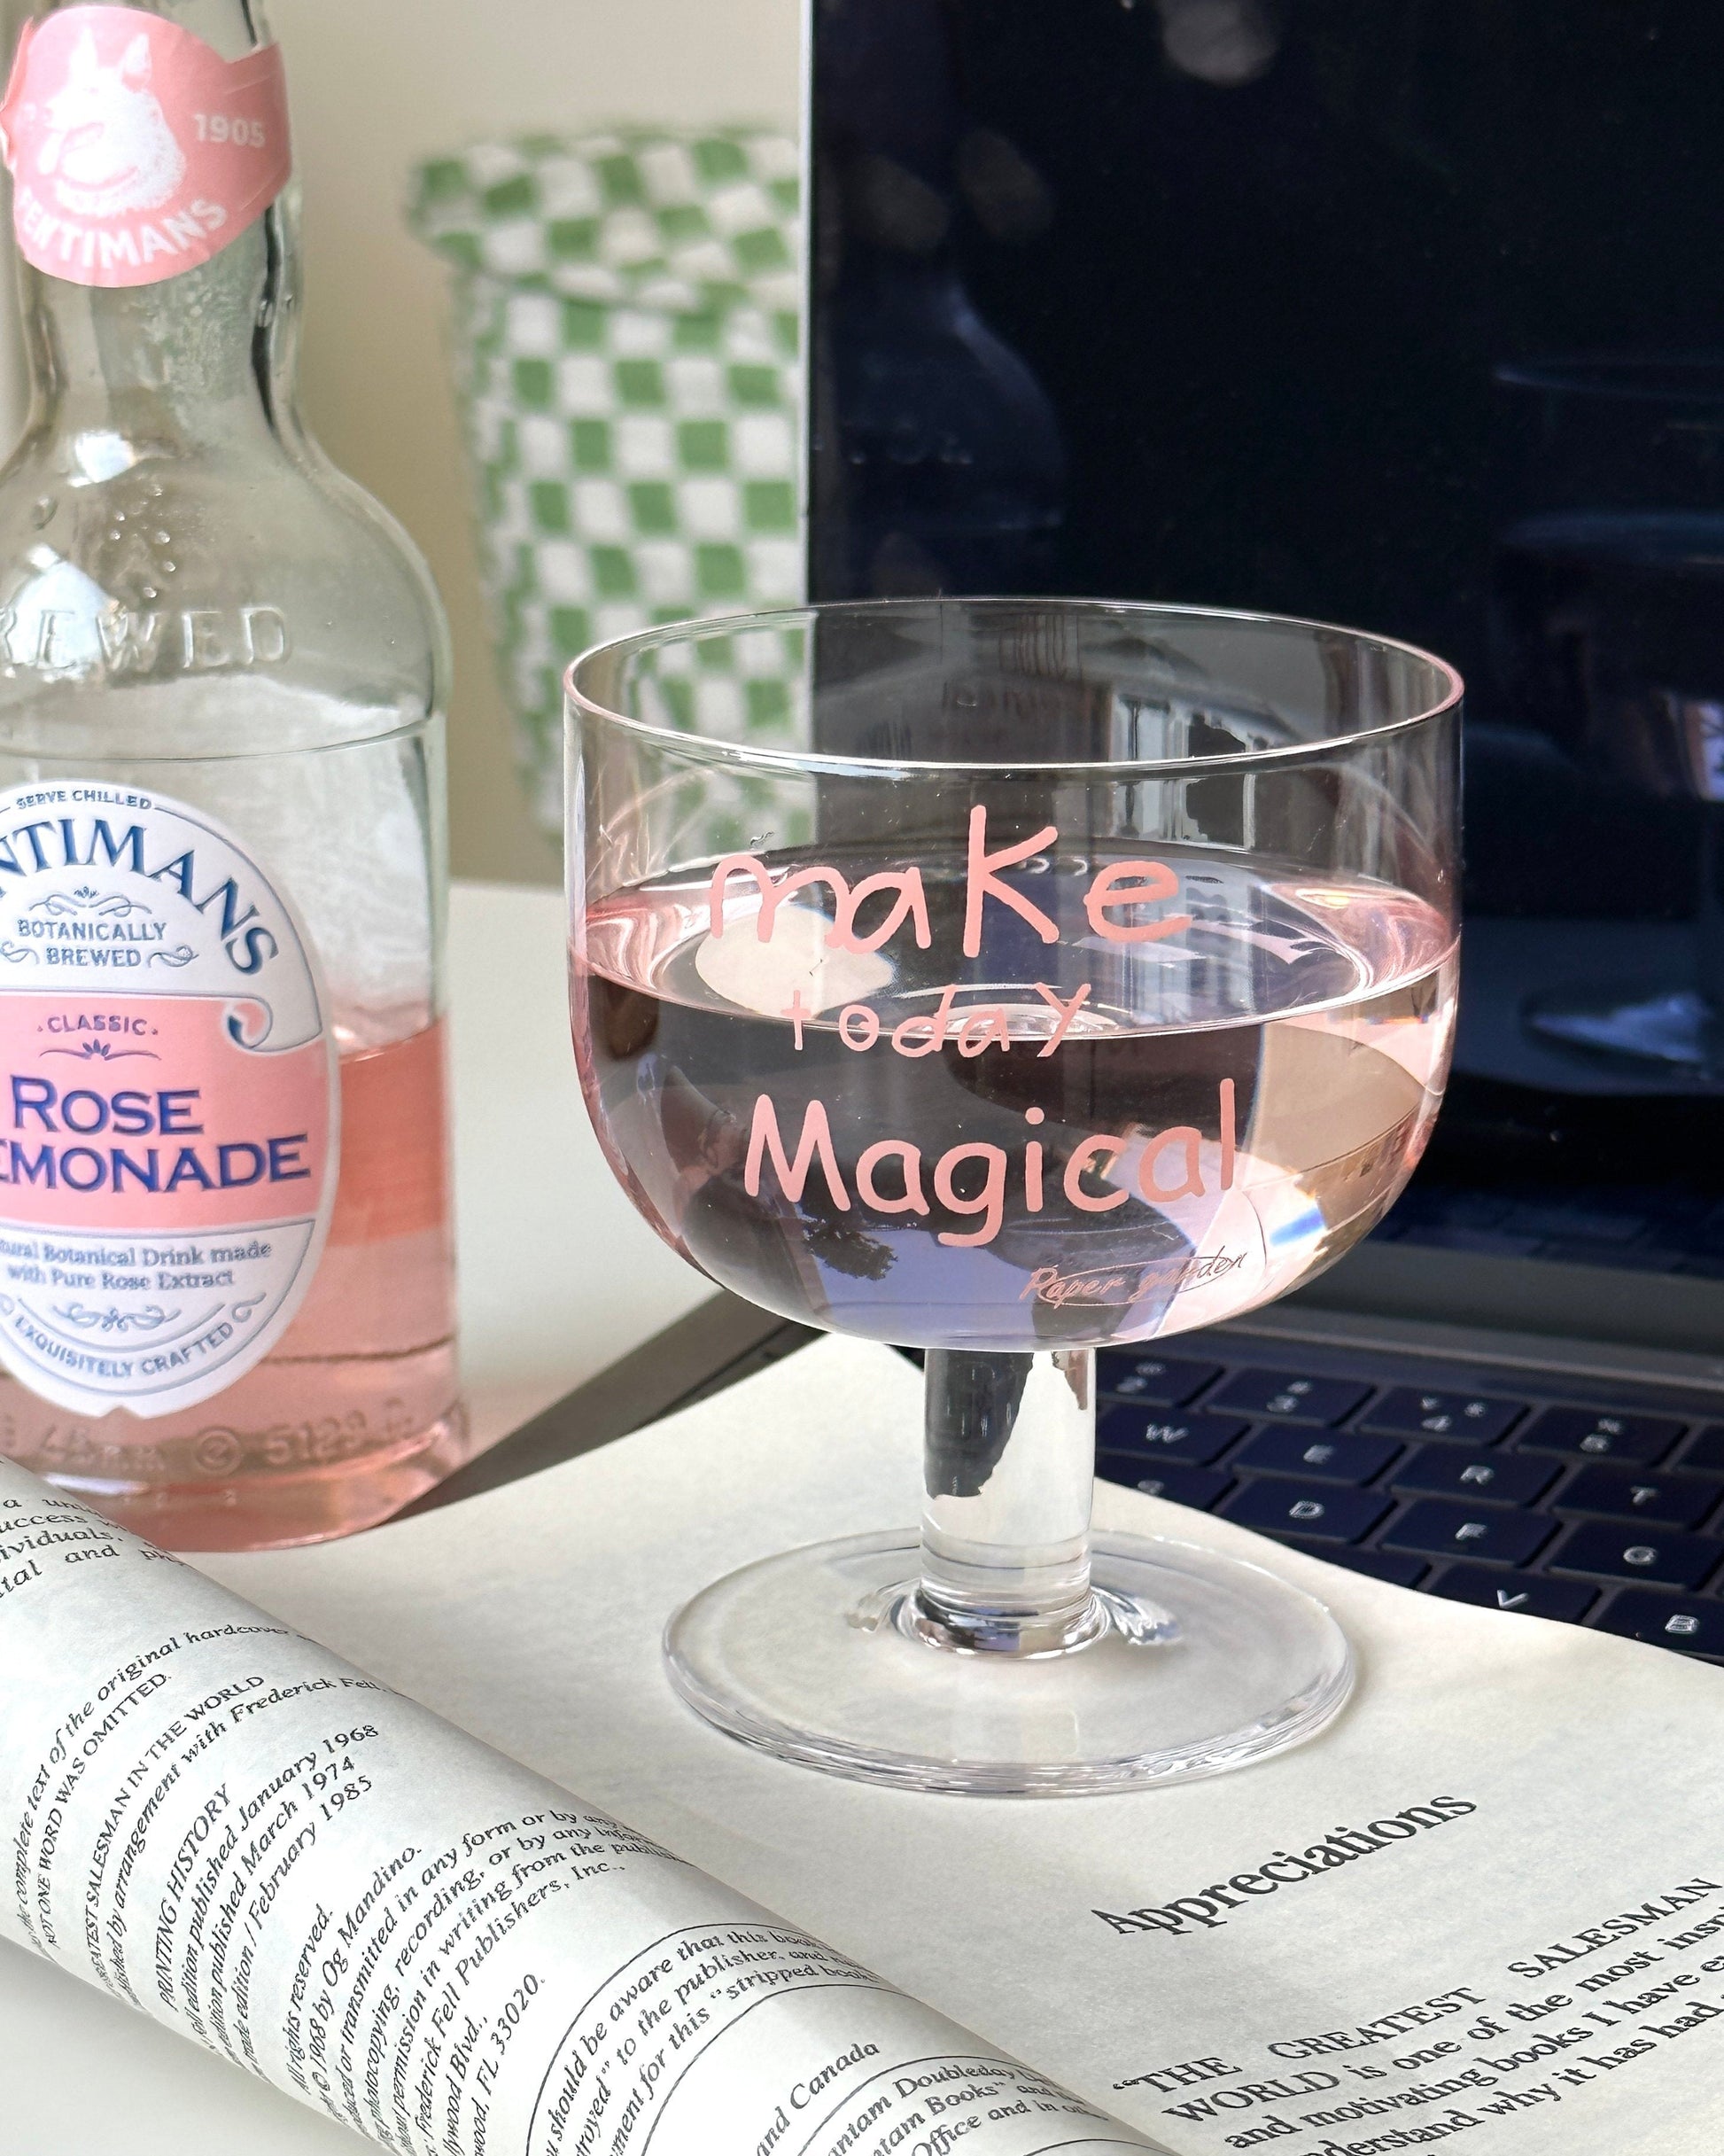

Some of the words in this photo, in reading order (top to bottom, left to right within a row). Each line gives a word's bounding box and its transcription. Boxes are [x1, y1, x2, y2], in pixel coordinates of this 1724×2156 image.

[193, 113, 265, 149] 1905
[16, 790, 66, 809] SERVE
[72, 789, 153, 810] CHILLED
[17, 920, 167, 941] BOTANICALLY
[46, 947, 142, 968] BREWED
[47, 1015, 148, 1036] CLASSIC
[10, 1075, 205, 1136] ROSE
[743, 1078, 1237, 1248] Magical
[7, 1264, 45, 1284] with
[50, 1268, 97, 1287] Pure
[101, 1271, 151, 1289] Rose
[157, 1269, 234, 1289] Extract
[43, 1241, 136, 1266] Botanical
[141, 1245, 204, 1266] Drink
[209, 1241, 273, 1263] made
[14, 1316, 133, 1378] EXQUISITELY
[141, 1321, 234, 1374] CRAFTED
[1145, 1422, 1190, 1444] W
[1289, 1499, 1325, 1520] D
[1630, 1486, 1660, 1505] T
[65, 1545, 120, 1563] and
[1497, 1589, 1529, 1608] V
[1665, 1614, 1701, 1634] B
[82, 1672, 172, 1756] OMITTED.
[230, 1677, 338, 1724] Frederick
[181, 1721, 229, 1764] with
[322, 1724, 380, 1755] 1968
[12, 1811, 34, 1906] complete
[27, 1763, 50, 1811] text
[50, 1727, 66, 1764] of
[65, 1701, 96, 1738] the
[97, 1637, 182, 1701] original
[54, 1756, 86, 1804] WAS
[86, 1786, 132, 1908] SALESMAN
[127, 1759, 150, 1788] IN
[144, 1719, 189, 1762] THE
[183, 1675, 266, 1722] WORLD
[237, 1751, 317, 1833] January
[39, 1808, 63, 1871] WORD
[113, 1761, 182, 1910] arrangement
[461, 1820, 518, 1857] form
[521, 1813, 546, 1827] or
[548, 1809, 578, 1825] by
[37, 1872, 51, 1915] ONE
[189, 1824, 238, 1952] published
[208, 1870, 247, 1994] published
[240, 1800, 299, 1877] March
[301, 1755, 356, 1802] 1974
[421, 1847, 458, 1887] any
[1090, 1794, 1479, 1936] Appreciations
[105, 1908, 128, 1939] by
[154, 1896, 179, 2013] PRINTING
[167, 1781, 231, 1903] HISTORY
[230, 1944, 255, 2021] edition
[247, 1821, 317, 1931] February
[318, 1774, 373, 1822] 1985
[337, 1847, 423, 1949] Mandino.
[394, 1885, 420, 1912] in
[180, 1942, 200, 2014] edition
[289, 1903, 334, 2012] reserved.
[321, 1947, 350, 1988] Og
[339, 1906, 399, 2045] transmitted
[363, 1982, 401, 2129] photocopying,
[393, 1868, 485, 1977] recording,
[488, 1846, 512, 1866] or
[516, 1833, 546, 1851] by
[552, 1825, 593, 1841] any
[391, 1989, 428, 2119] permission
[420, 1959, 441, 1988] in
[437, 1880, 513, 1956] writing
[510, 1850, 568, 1890] from
[569, 1842, 606, 1858] the
[1267, 1987, 1487, 2060] GREATEST
[1506, 1877, 1724, 1979] SALESMAN
[312, 1989, 335, 2021] by
[414, 2036, 442, 2141] Frederick
[431, 1981, 462, 2039] Fell
[454, 1878, 571, 1986] Publishers,
[616, 2037, 637, 2066] to
[637, 1998, 673, 2037] the
[673, 1949, 786, 2006] publisher,
[788, 1950, 829, 1962] and
[282, 2010, 307, 2069] rights
[309, 2017, 329, 2074] 1968
[339, 2043, 354, 2074] or
[449, 2013, 489, 2082] Blvd.,
[476, 2058, 500, 2098] FL
[490, 1973, 547, 2056] 33020.
[547, 2048, 589, 2142] should
[579, 2021, 609, 2056] be
[609, 1958, 674, 2022] aware
[676, 1934, 726, 1962] that
[725, 1930, 769, 1945] this
[639, 2048, 667, 2102] for
[668, 2006, 711, 2051] this
[1161, 2070, 1342, 2122] WORLD
[1341, 2064, 1388, 2080] is
[1391, 2040, 1463, 2071] one
[1466, 2015, 1511, 2040] of
[1504, 1994, 1573, 2022] the
[1574, 1950, 1666, 1993] most
[1223, 2114, 1304, 2149] and
[1299, 2067, 1499, 2129] motivating
[1472, 2027, 1595, 2072] books
[1580, 2011, 1623, 2028] I
[1602, 1973, 1702, 2015] have
[1476, 2082, 1562, 2115] why
[1551, 2067, 1598, 2086] it
[1575, 2038, 1658, 2071] has
[1637, 2000, 1724, 2039] had
[756, 2105, 791, 2156] and
[788, 2040, 881, 2110] Canada
[891, 2063, 1016, 2099] Doubleday
[1016, 2084, 1058, 2098] and
[910, 2115, 982, 2156] Office
[987, 2099, 1032, 2121] and
